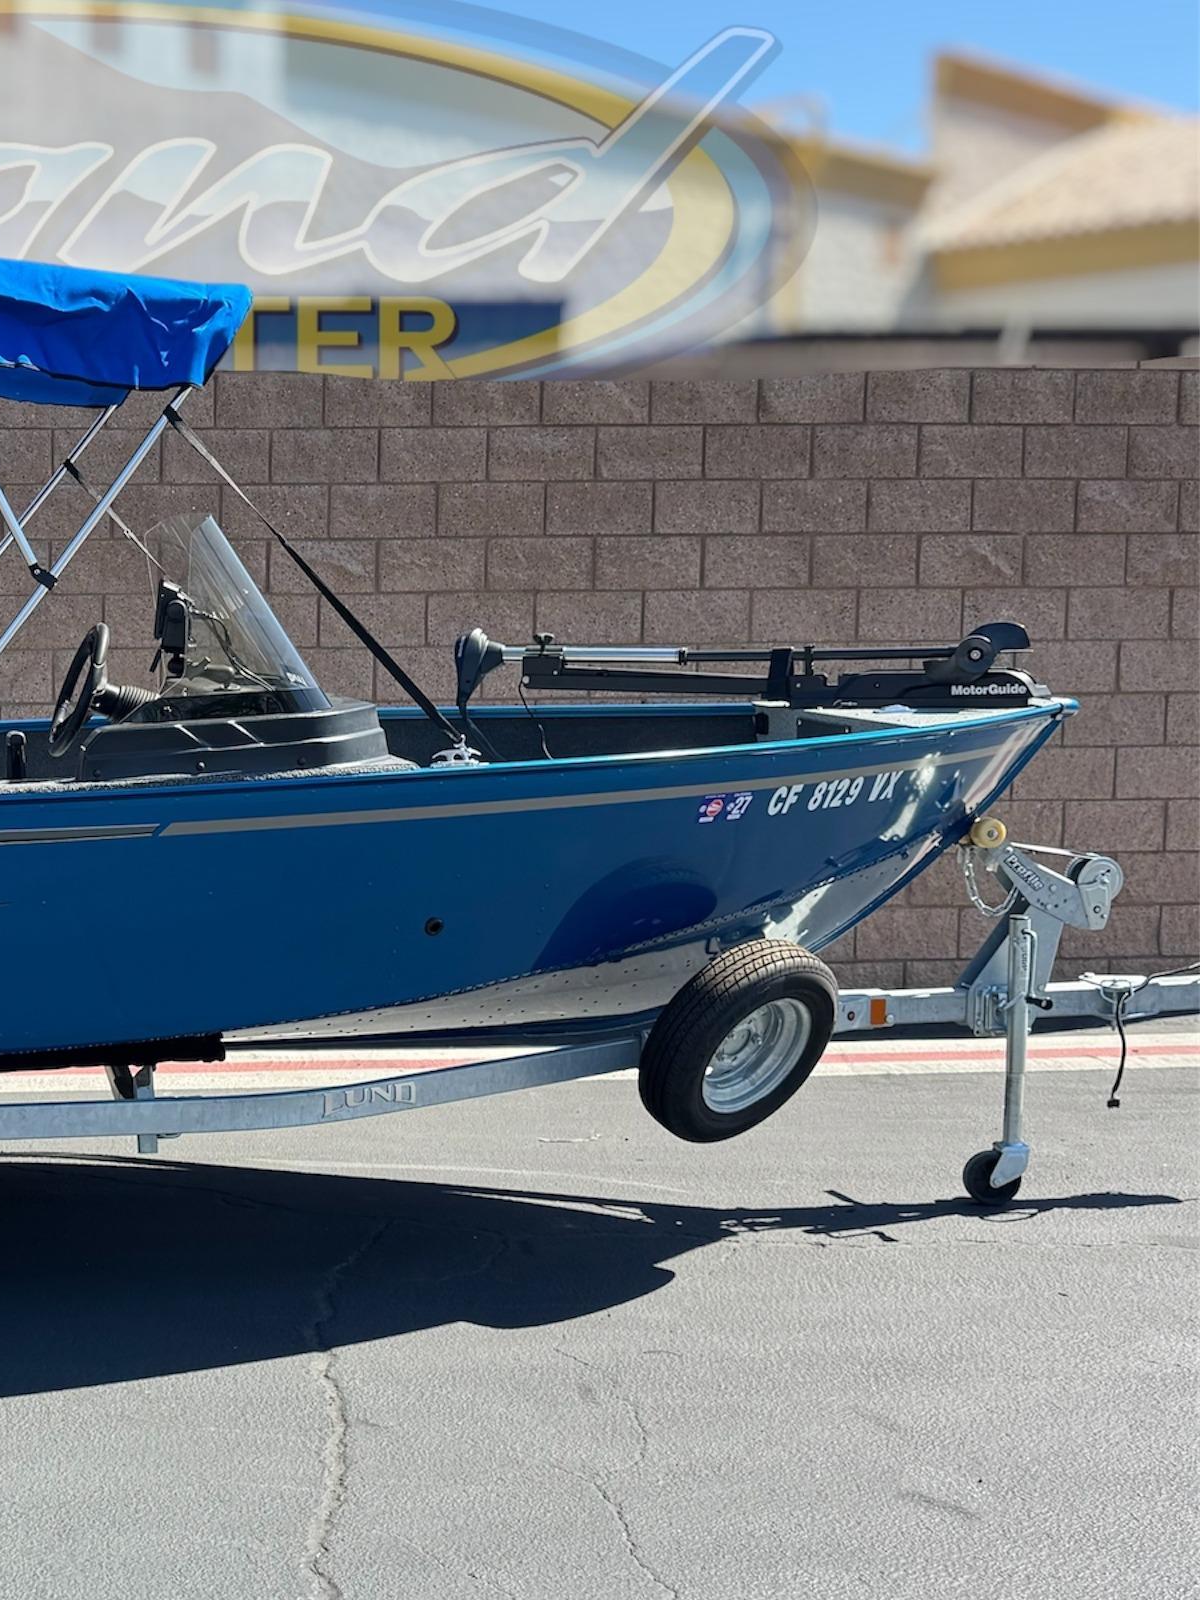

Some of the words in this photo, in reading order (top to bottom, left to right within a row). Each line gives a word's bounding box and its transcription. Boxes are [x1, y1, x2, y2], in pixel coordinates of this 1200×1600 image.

[951, 683, 1028, 696] MotorGuide
[767, 783, 805, 816] CF
[807, 776, 865, 812] 8129
[867, 770, 904, 802] VX
[1005, 855, 1045, 890] Profile
[321, 1081, 417, 1119] LUND
